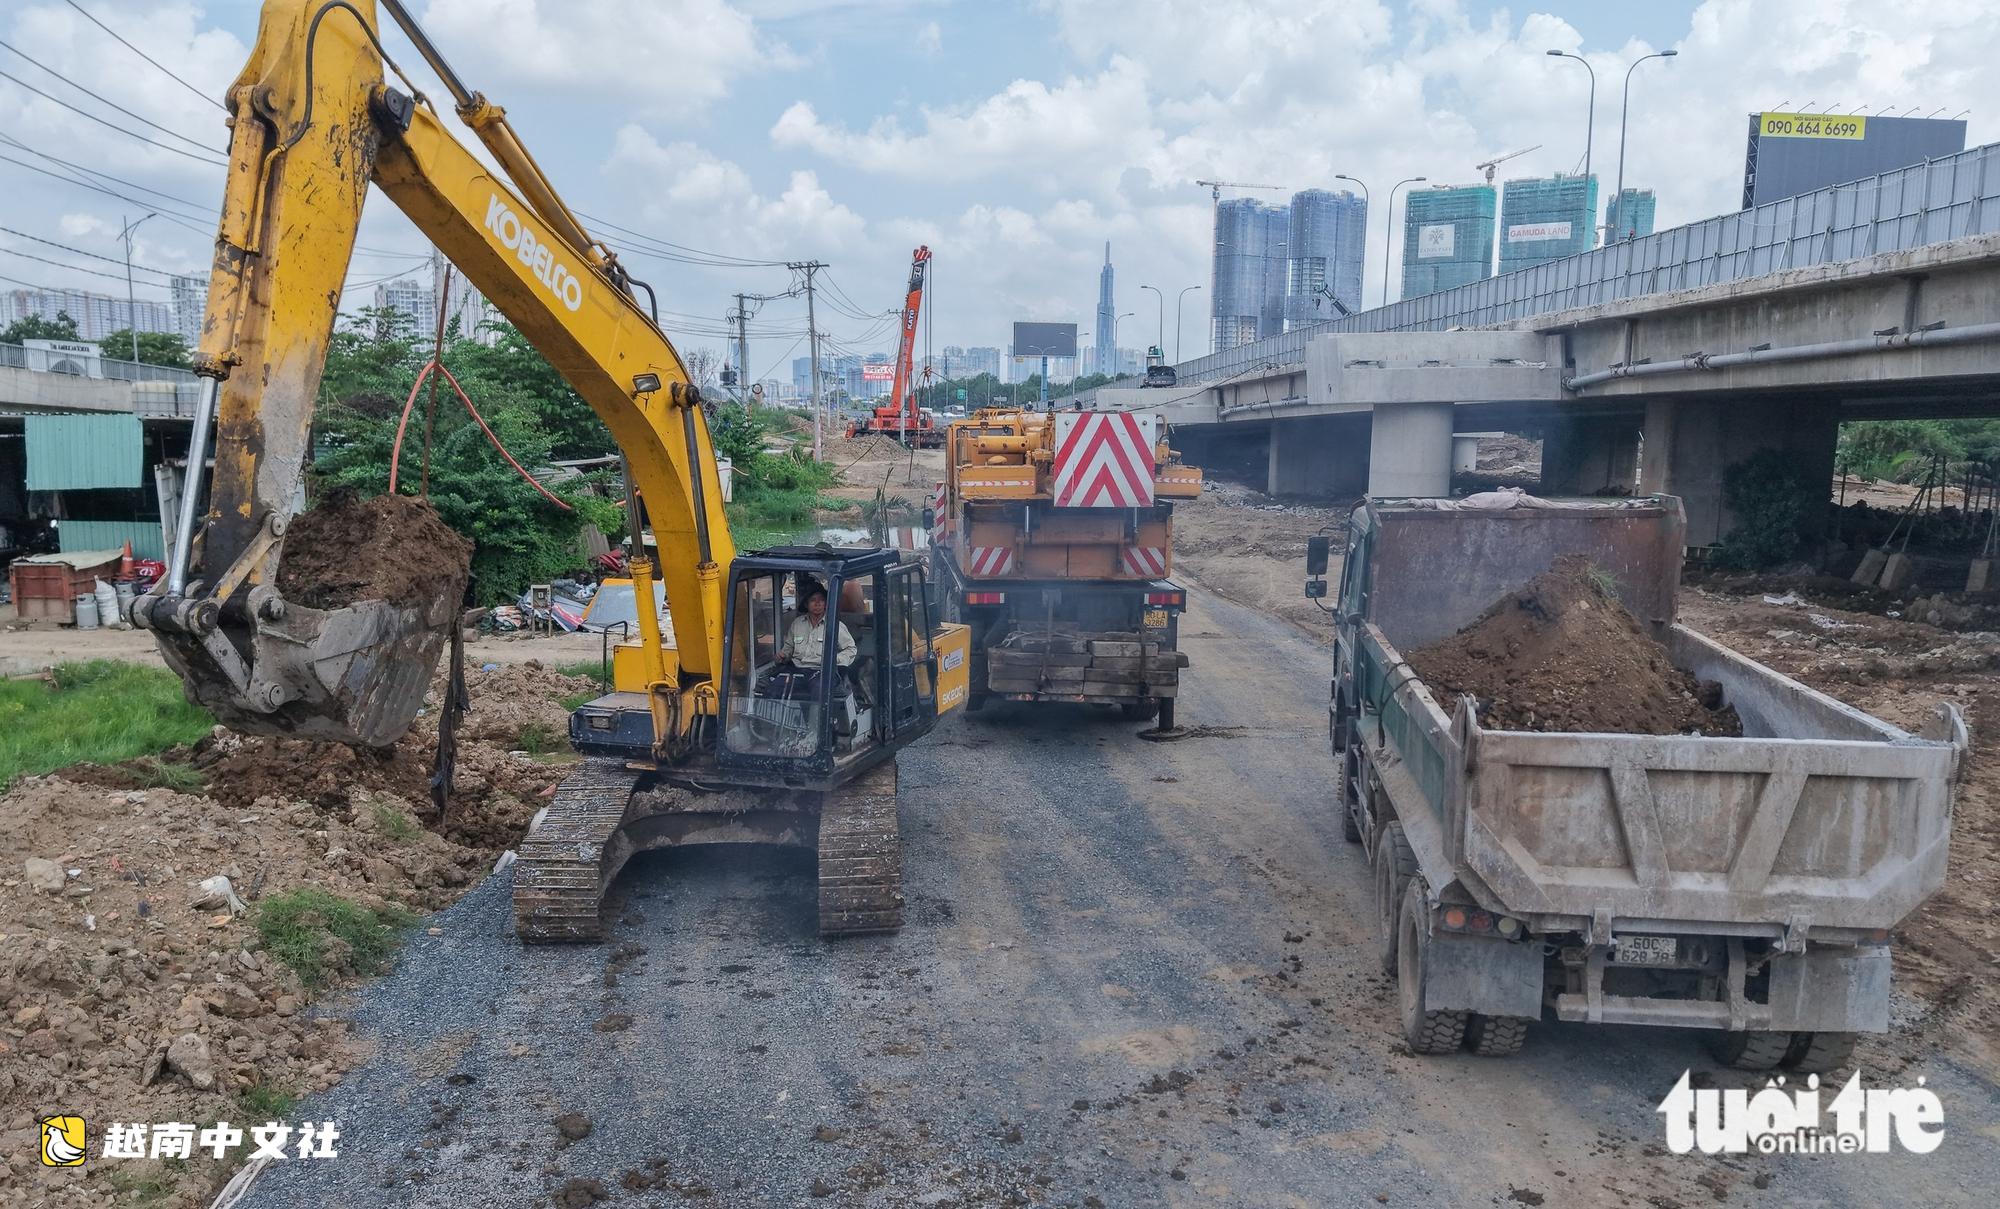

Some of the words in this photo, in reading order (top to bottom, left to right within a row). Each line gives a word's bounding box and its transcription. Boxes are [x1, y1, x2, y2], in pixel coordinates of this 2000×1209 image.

[1767, 120, 1792, 134] 090
[1796, 121, 1820, 135] 464
[1824, 122, 1857, 137] 6699
[1510, 227, 1546, 237] GAMUDA
[1547, 226, 1570, 235] LAND
[485, 193, 582, 312] KOBELCO
[907, 308, 915, 330] KATO
